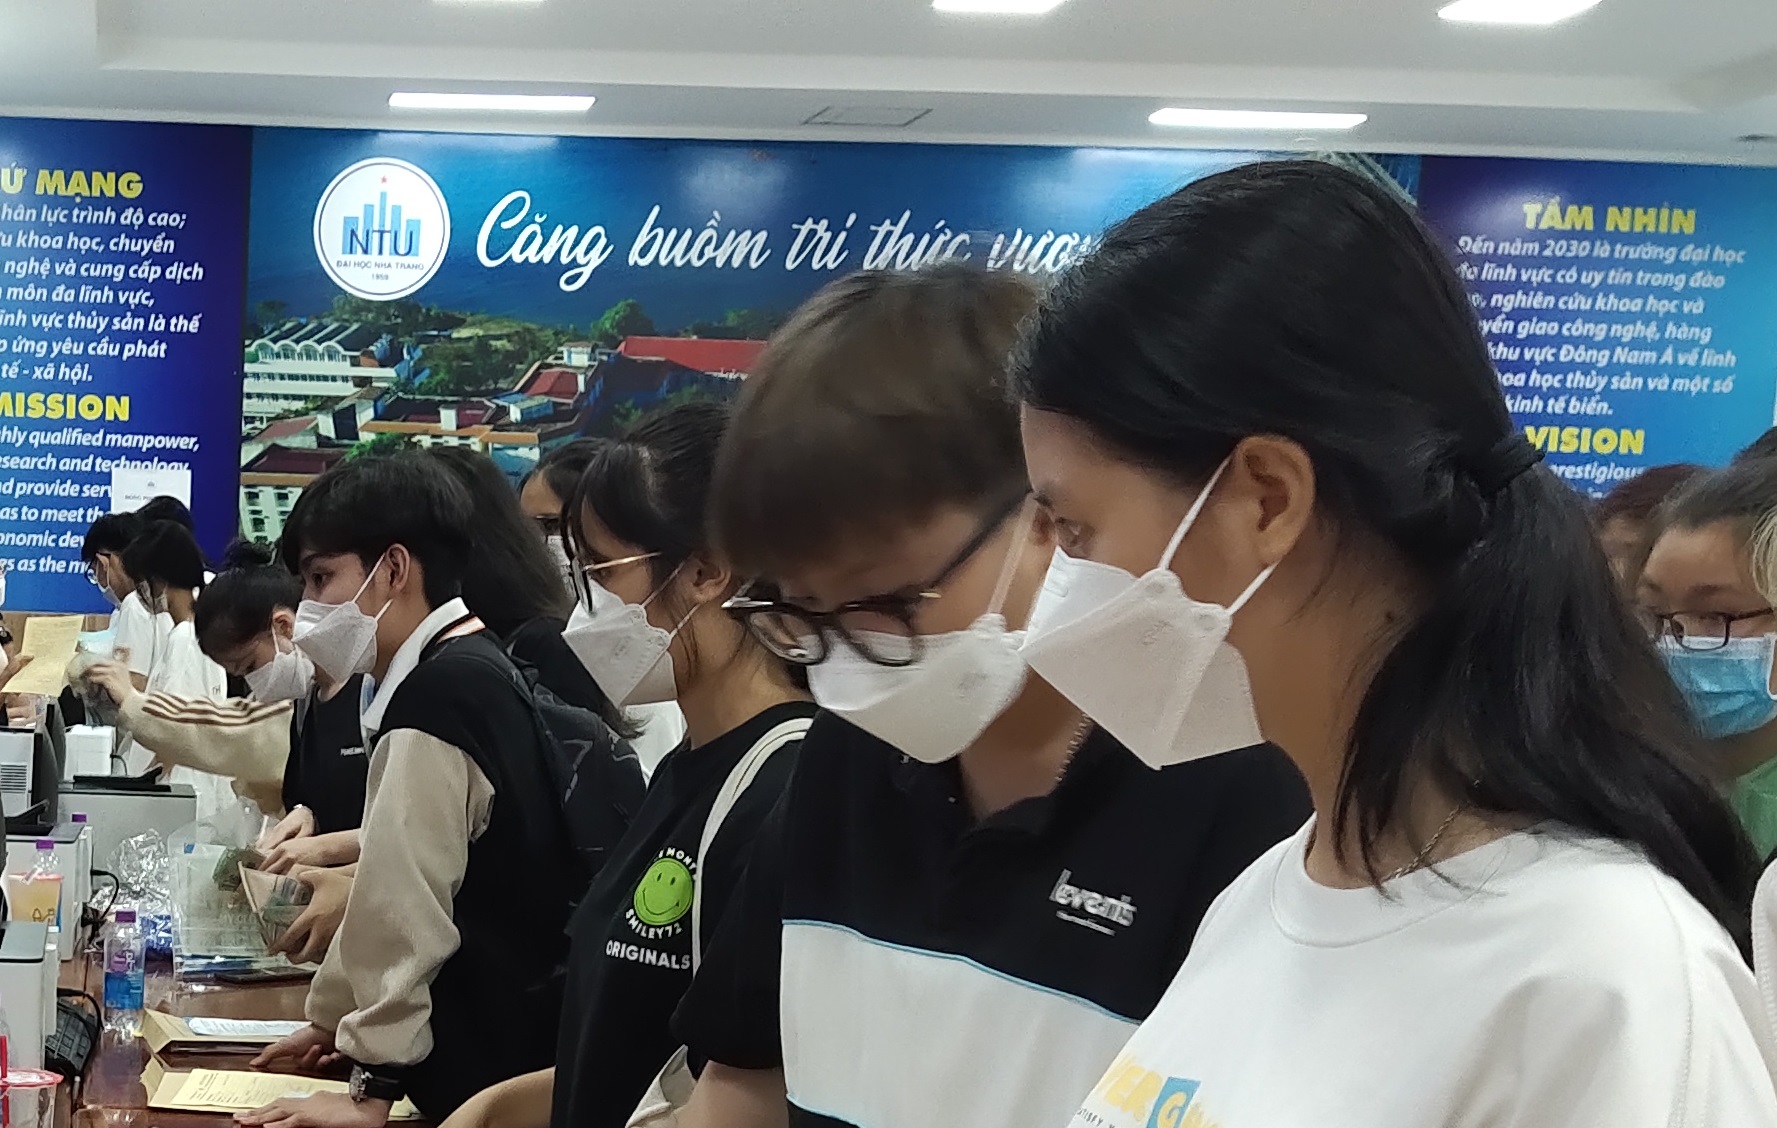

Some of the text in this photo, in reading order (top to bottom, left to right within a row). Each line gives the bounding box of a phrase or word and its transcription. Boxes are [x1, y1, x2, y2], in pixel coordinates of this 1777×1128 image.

[36, 169, 143, 202] MẠNG
[41, 205, 68, 226] lực
[72, 205, 116, 225] trình
[121, 207, 145, 231] độ
[148, 212, 186, 229] cao;
[17, 231, 63, 250] khoa
[67, 235, 105, 254] học,
[109, 232, 175, 257] chuyển
[349, 228, 413, 257] NTU
[476, 190, 613, 292] Căng
[628, 204, 773, 270] buồm
[785, 212, 858, 271] tri
[1542, 239, 1591, 257] 2030
[4, 258, 50, 279] nghệ
[55, 260, 76, 276] và
[81, 265, 124, 282] cung
[129, 262, 161, 283] cấp
[166, 262, 204, 285] dịch
[7, 283, 47, 302] môn
[52, 285, 76, 303] đa
[79, 285, 113, 304] lĩnh
[118, 290, 155, 309] vực,
[32, 311, 63, 331] vực
[148, 314, 166, 332] là
[170, 314, 201, 334] thế
[12, 335, 47, 357] ứng
[52, 338, 83, 358] yêu
[88, 338, 119, 358] cầu
[124, 340, 167, 361] phát
[1, 359, 20, 379] tế
[33, 364, 54, 380] xã
[58, 363, 93, 386] hội.
[28, 427, 103, 449] qualified
[104, 431, 200, 453] manpower,
[1525, 426, 1645, 455] VISION
[58, 455, 91, 473] and
[14, 479, 79, 500] provide
[20, 506, 38, 521] to
[40, 507, 84, 523] meet
[17, 557, 36, 572] as
[38, 555, 66, 573] the
[605, 940, 691, 970] ORIGINALS
